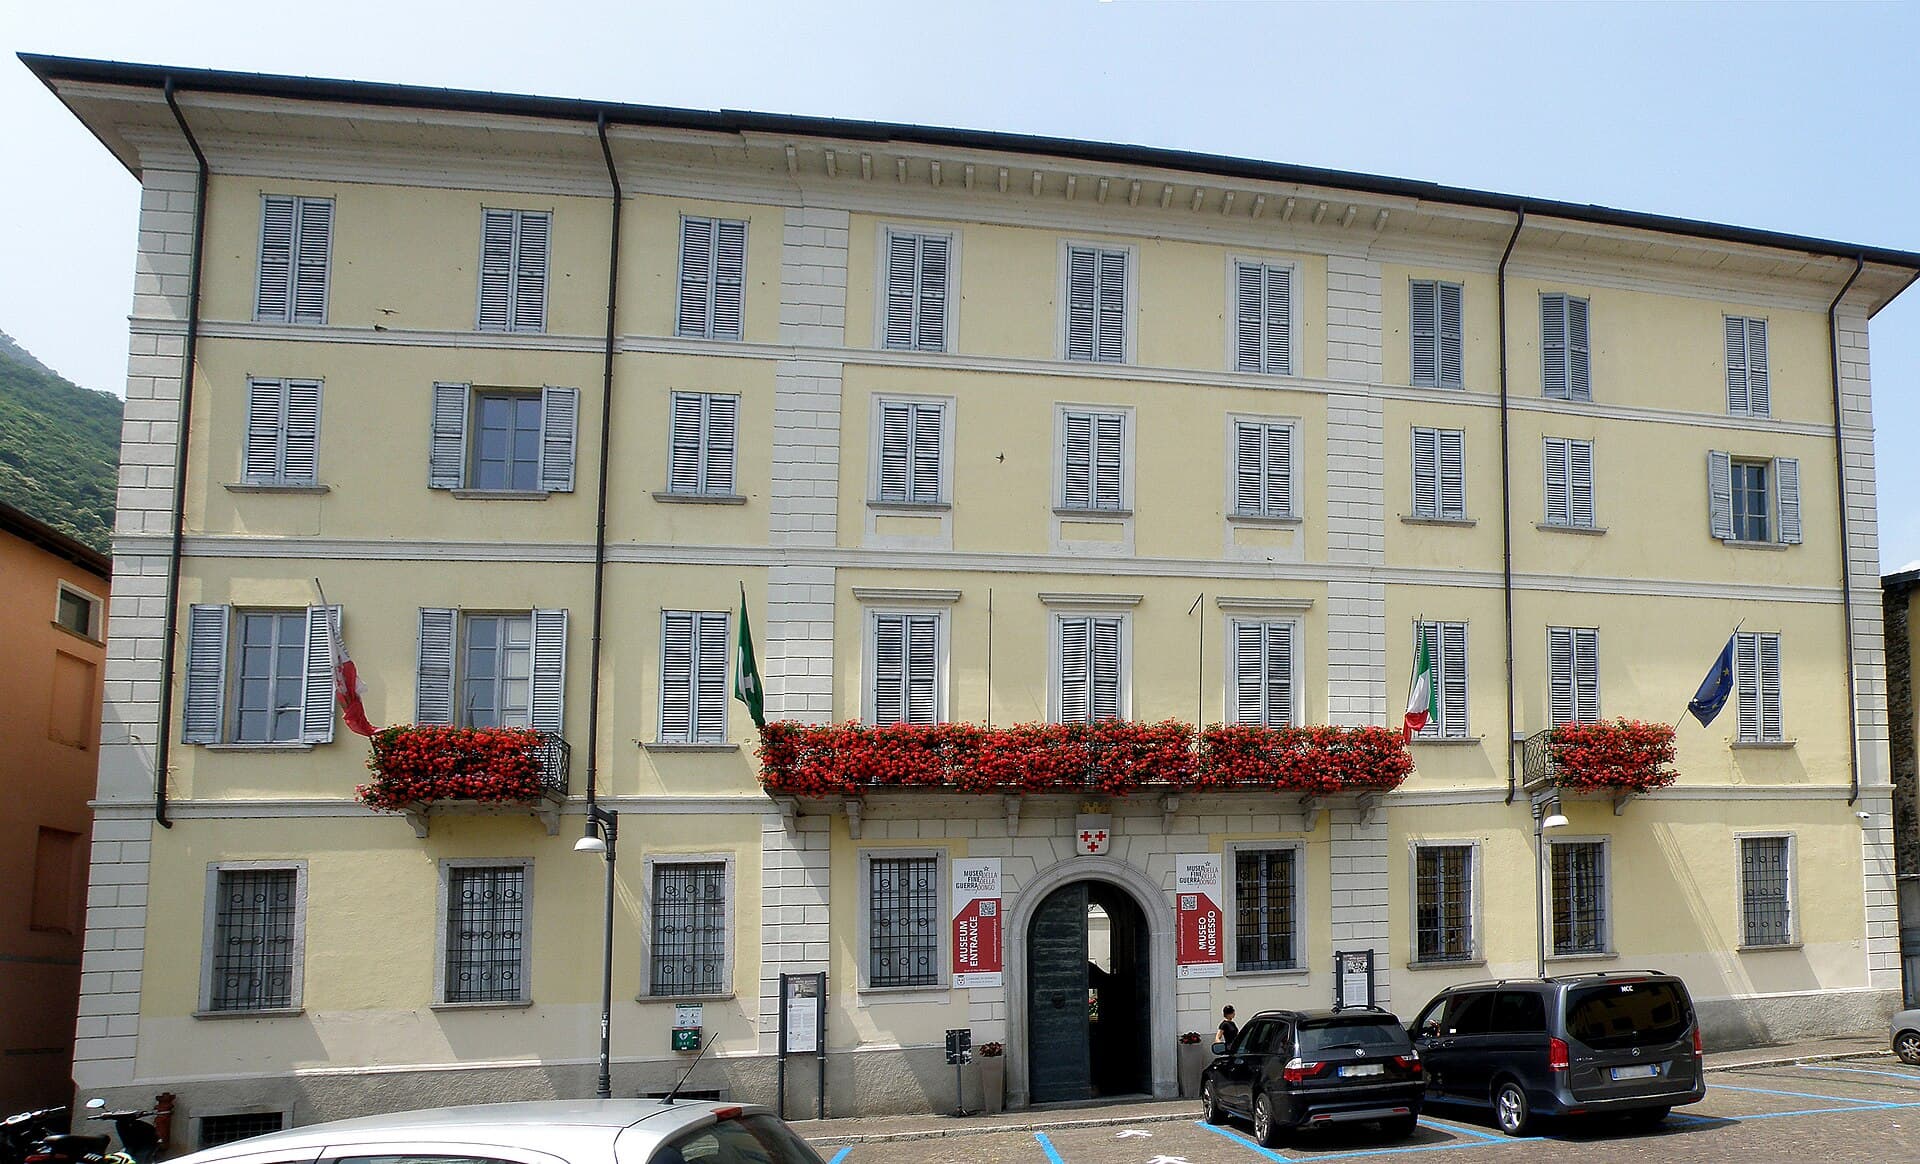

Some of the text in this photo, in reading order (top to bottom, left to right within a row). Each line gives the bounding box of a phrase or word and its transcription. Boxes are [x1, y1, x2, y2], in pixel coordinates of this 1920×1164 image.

[960, 921, 968, 963] MUSEUM
[970, 916, 978, 967] ENTRANCE
[1199, 917, 1207, 950] MUSEO
[1208, 910, 1216, 956] INGRESSO
